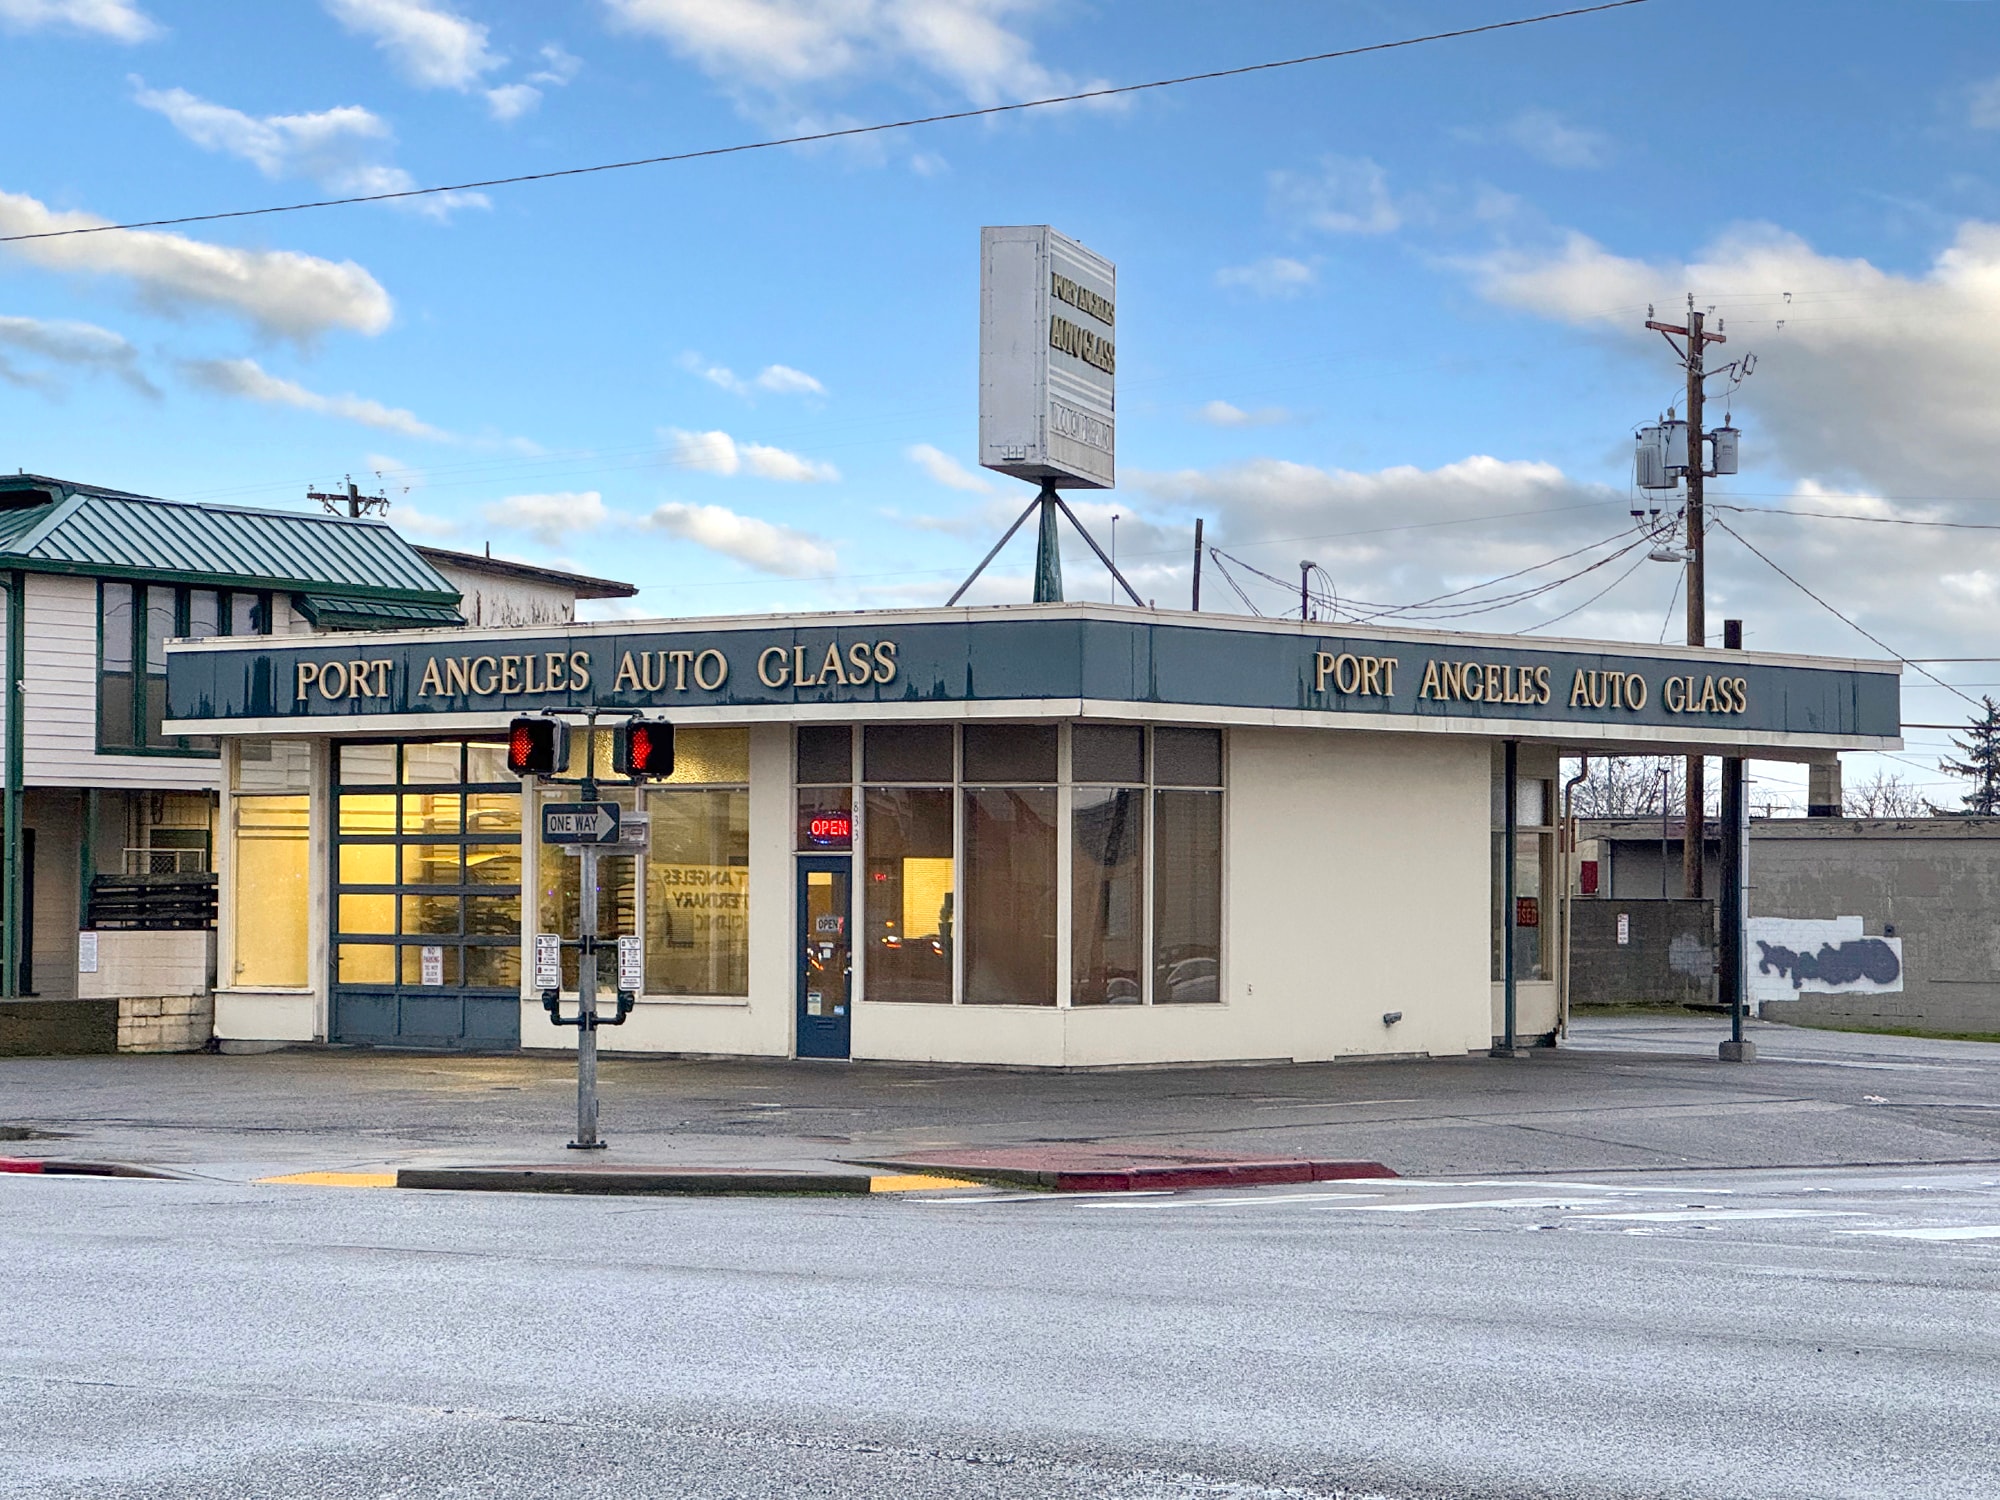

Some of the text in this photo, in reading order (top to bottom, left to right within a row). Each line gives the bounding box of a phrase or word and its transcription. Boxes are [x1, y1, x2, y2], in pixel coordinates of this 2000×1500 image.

[1050, 314, 1115, 375] AUTO GLASS
[296, 641, 897, 701] PORT ANGELES AUTO GLASS
[1316, 652, 1747, 714] PORT ANGELES AUTO GLASS
[550, 815, 598, 831] ONE WAY
[811, 820, 848, 836] OPEN
[818, 918, 838, 930] OPEN
[427, 947, 435, 955] NO
